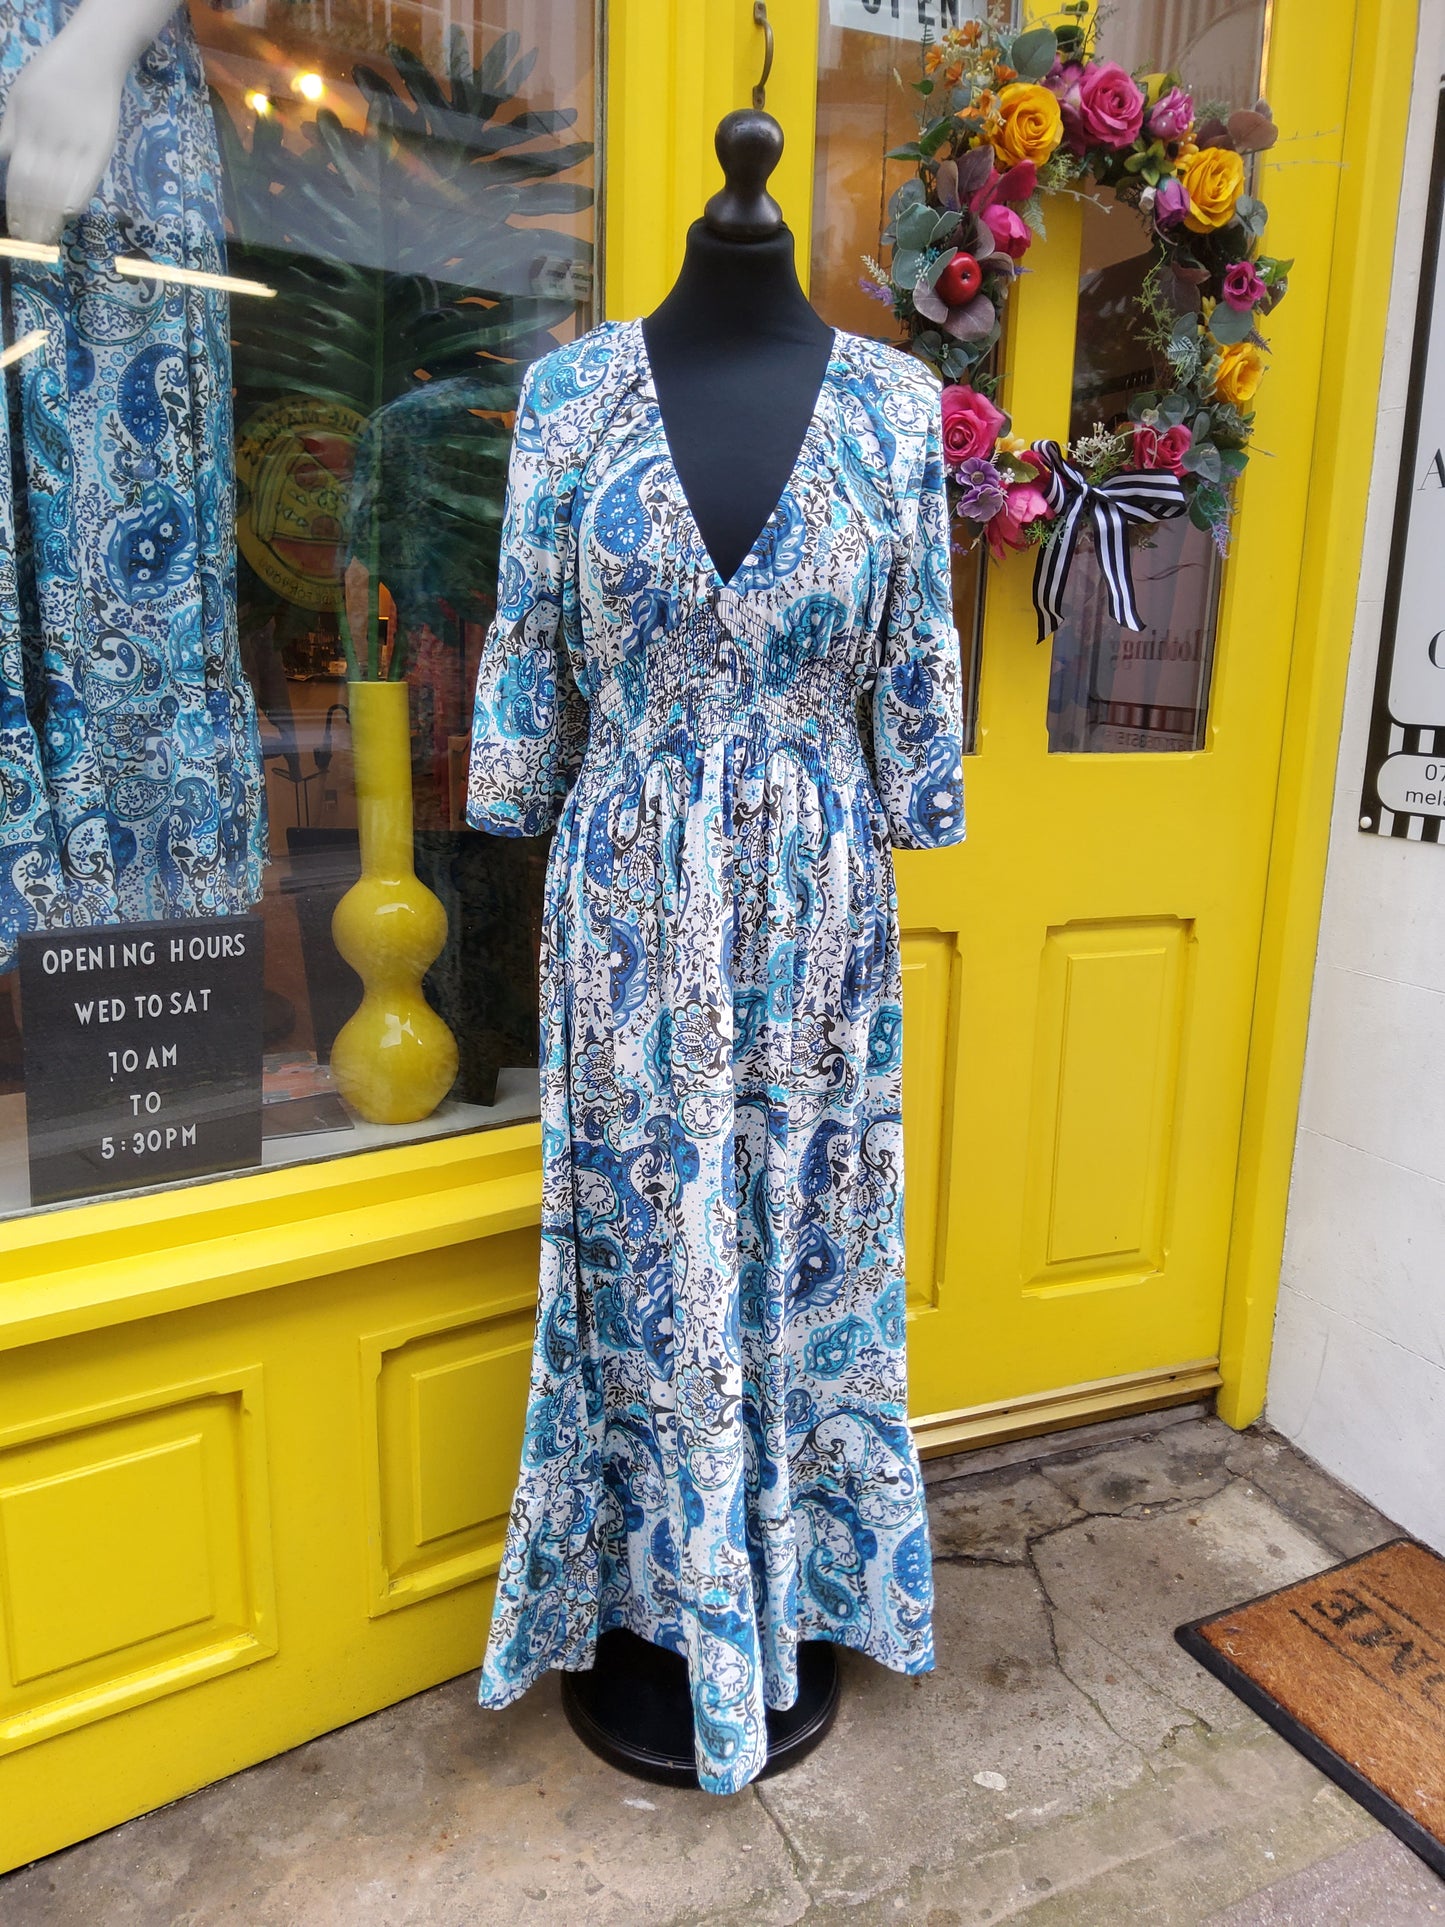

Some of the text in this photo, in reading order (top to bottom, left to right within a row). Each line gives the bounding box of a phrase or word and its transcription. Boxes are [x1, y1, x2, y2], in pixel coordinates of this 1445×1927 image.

[1405, 789, 1445, 807] mel
[42, 933, 246, 975] OPENING HOURS
[74, 988, 212, 1026] WED TO SAT
[145, 1043, 177, 1071] AM
[130, 1091, 161, 1116] TO
[101, 1124, 197, 1160] 5:30PM
